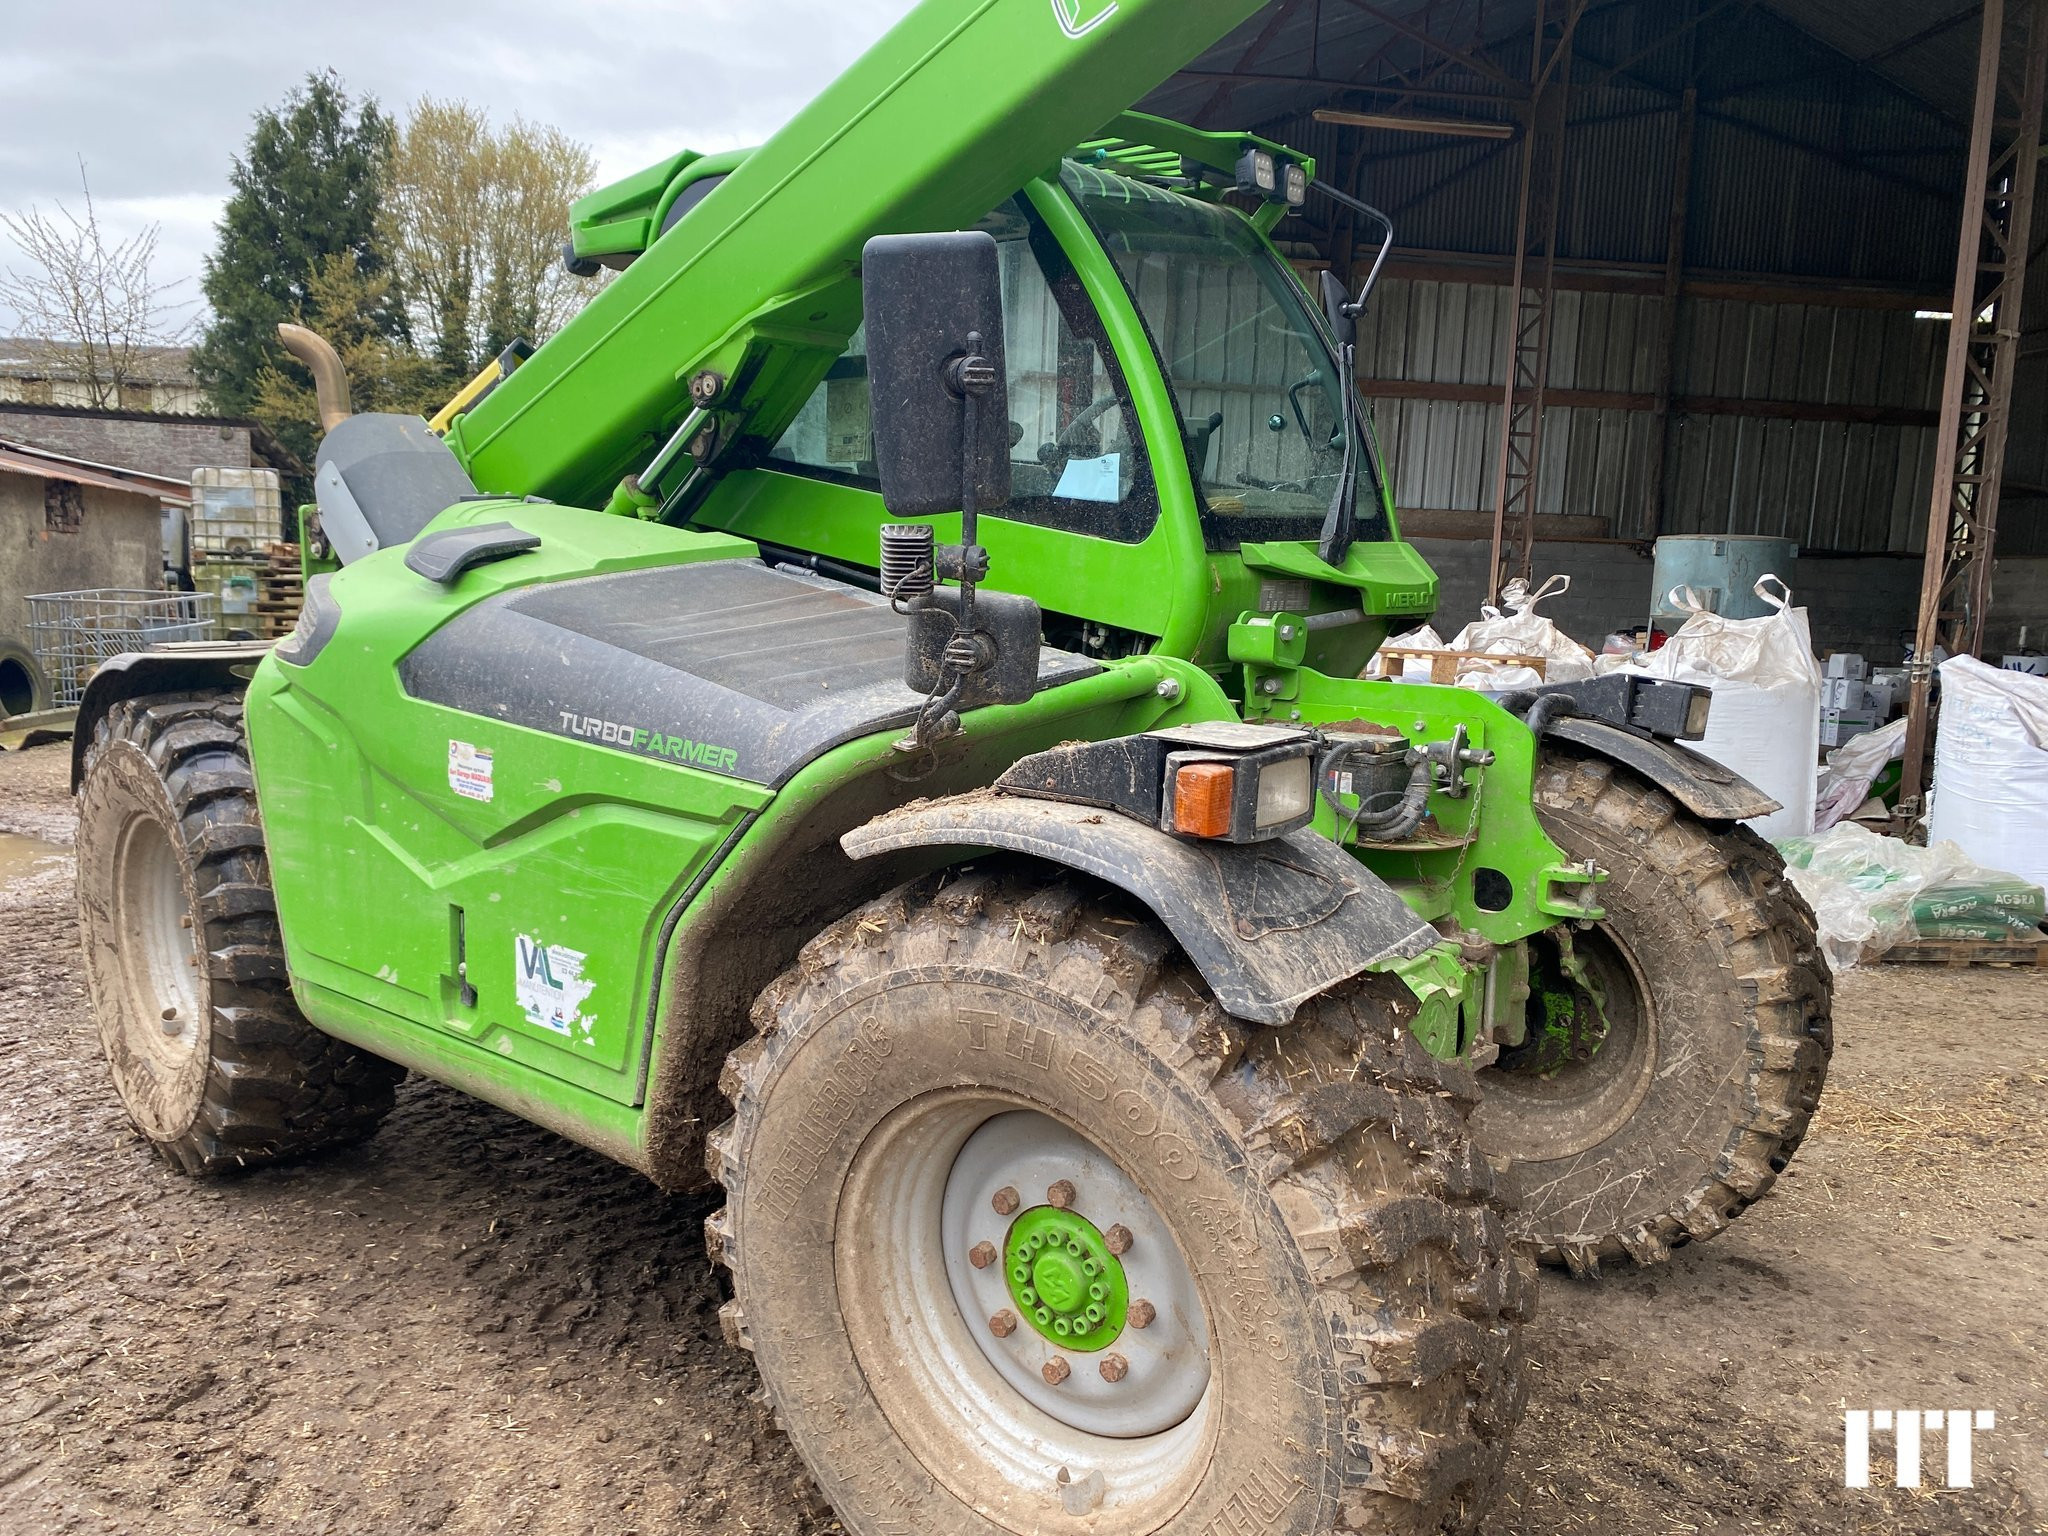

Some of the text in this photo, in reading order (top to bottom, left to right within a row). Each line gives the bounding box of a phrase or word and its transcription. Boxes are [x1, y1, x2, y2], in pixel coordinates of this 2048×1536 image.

[1386, 592, 1429, 608] MERLO
[559, 711, 738, 771] TURBOFARMER
[519, 937, 564, 991] VAL
[752, 1015, 894, 1223] TRELLEBORG
